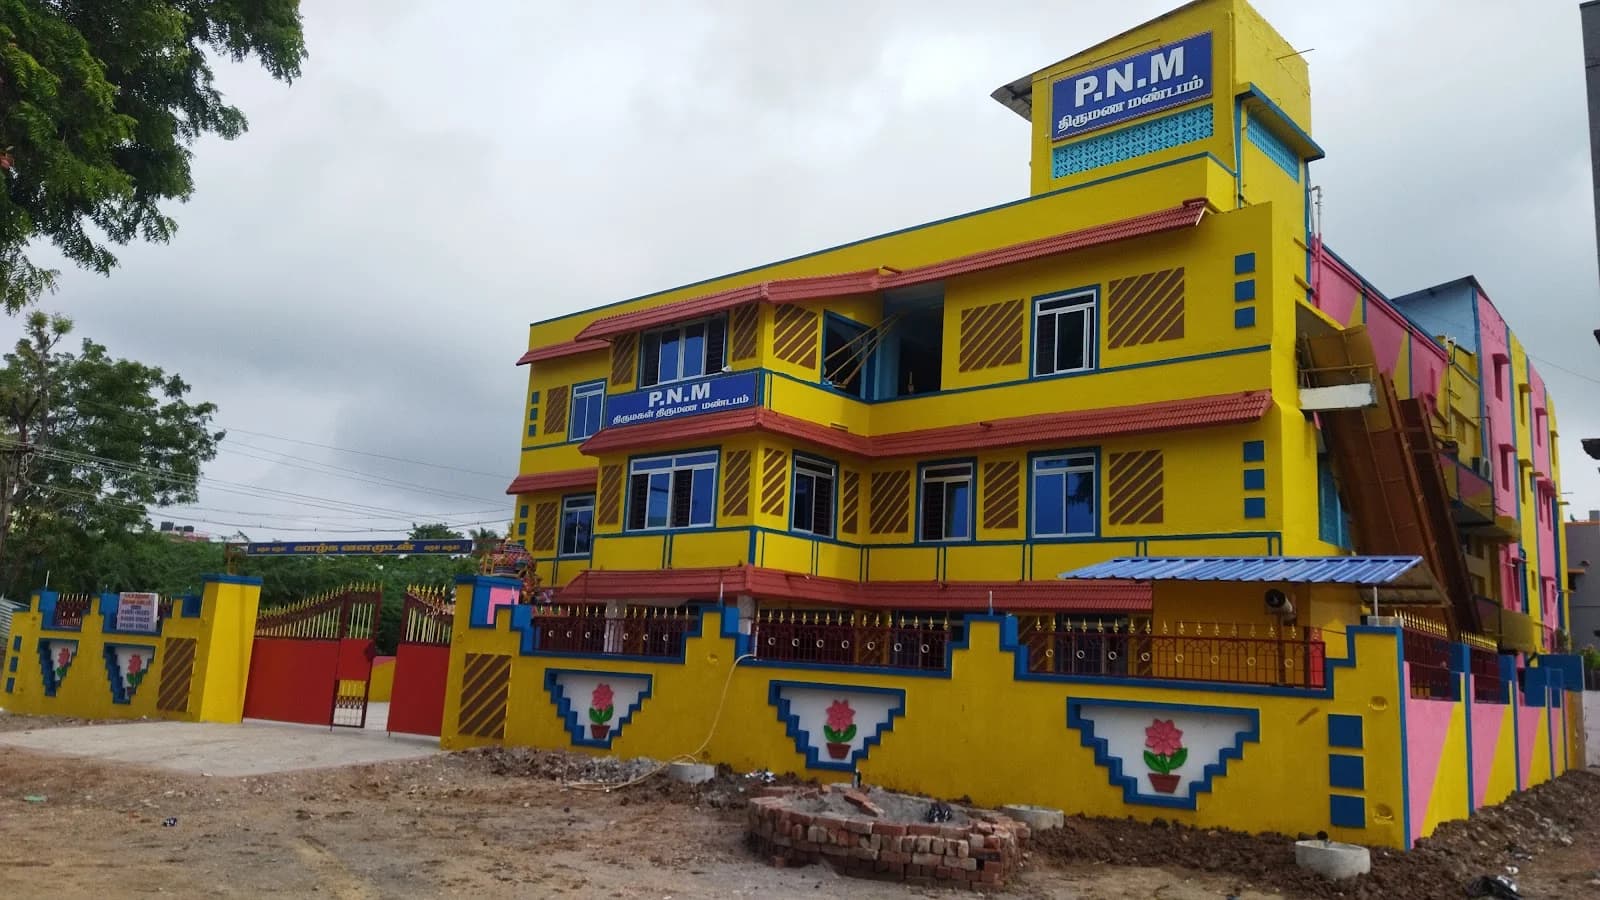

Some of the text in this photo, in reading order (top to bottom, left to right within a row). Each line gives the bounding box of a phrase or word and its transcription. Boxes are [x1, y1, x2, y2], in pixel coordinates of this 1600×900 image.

[1075, 47, 1184, 108] P.N.M
[1058, 75, 1204, 133] திருமண மண்டபம்
[612, 394, 749, 425] திருமகள் திருமண மண்டபம்
[648, 383, 711, 407] P.N.M
